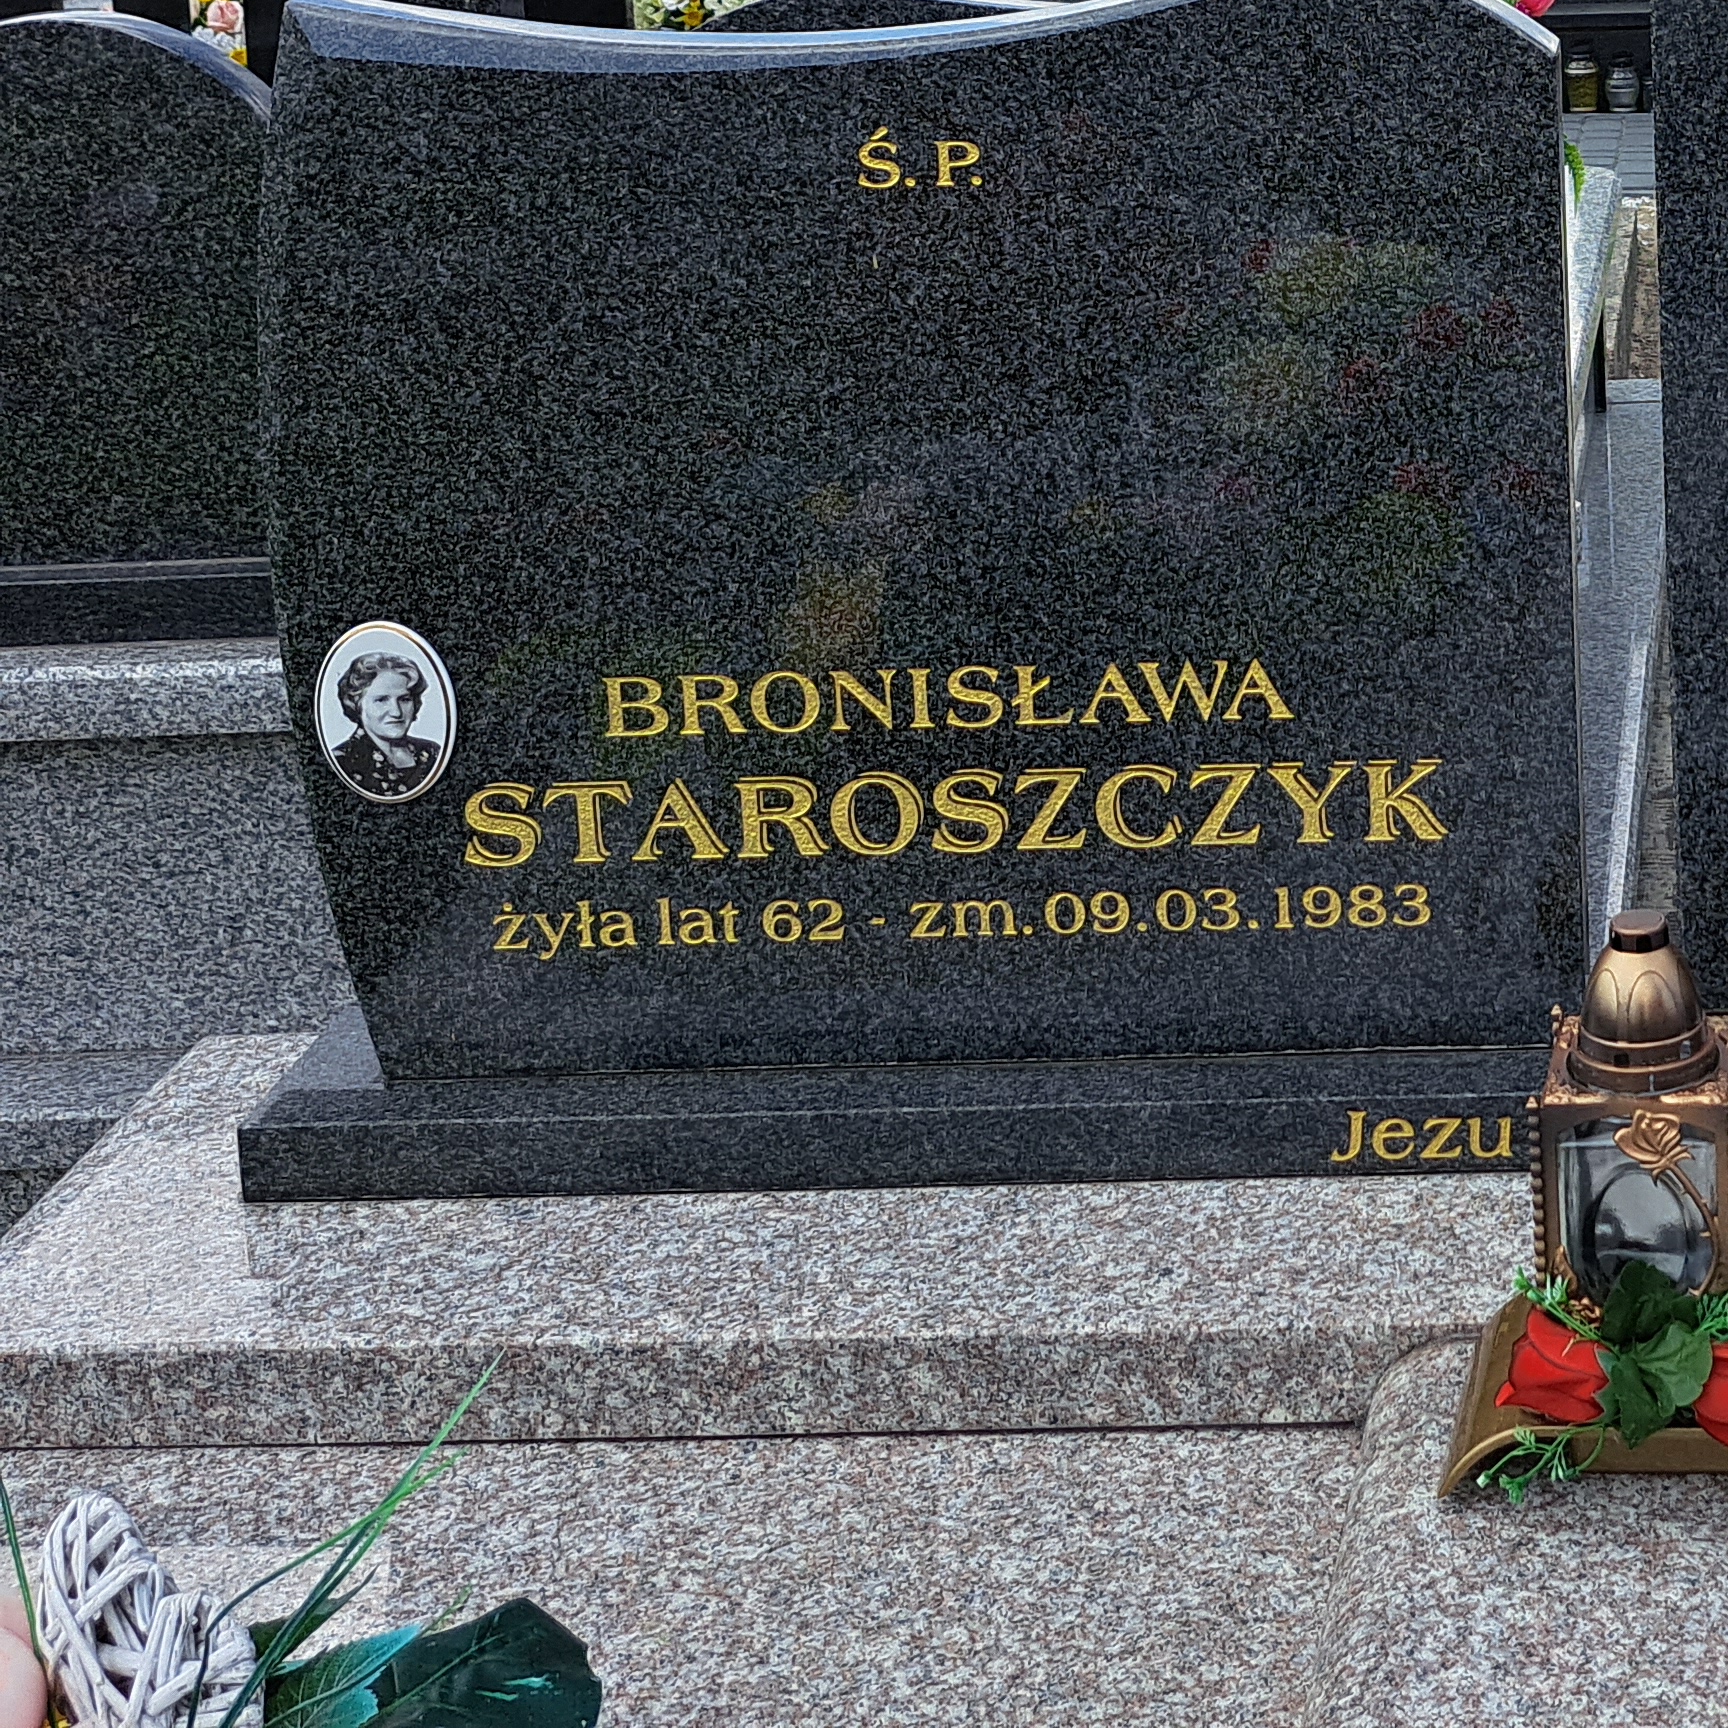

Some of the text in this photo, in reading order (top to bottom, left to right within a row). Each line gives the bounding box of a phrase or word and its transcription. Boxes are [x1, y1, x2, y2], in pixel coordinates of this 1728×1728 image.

[857, 125, 984, 189] Ś. P.
[602, 657, 1296, 739] BRONISŁAWA
[463, 758, 1450, 868] STAROSZCZYK
[493, 898, 638, 961] żyła
[656, 896, 741, 946] lat
[761, 897, 846, 943] 62
[1330, 1110, 1514, 1162] Jezu
